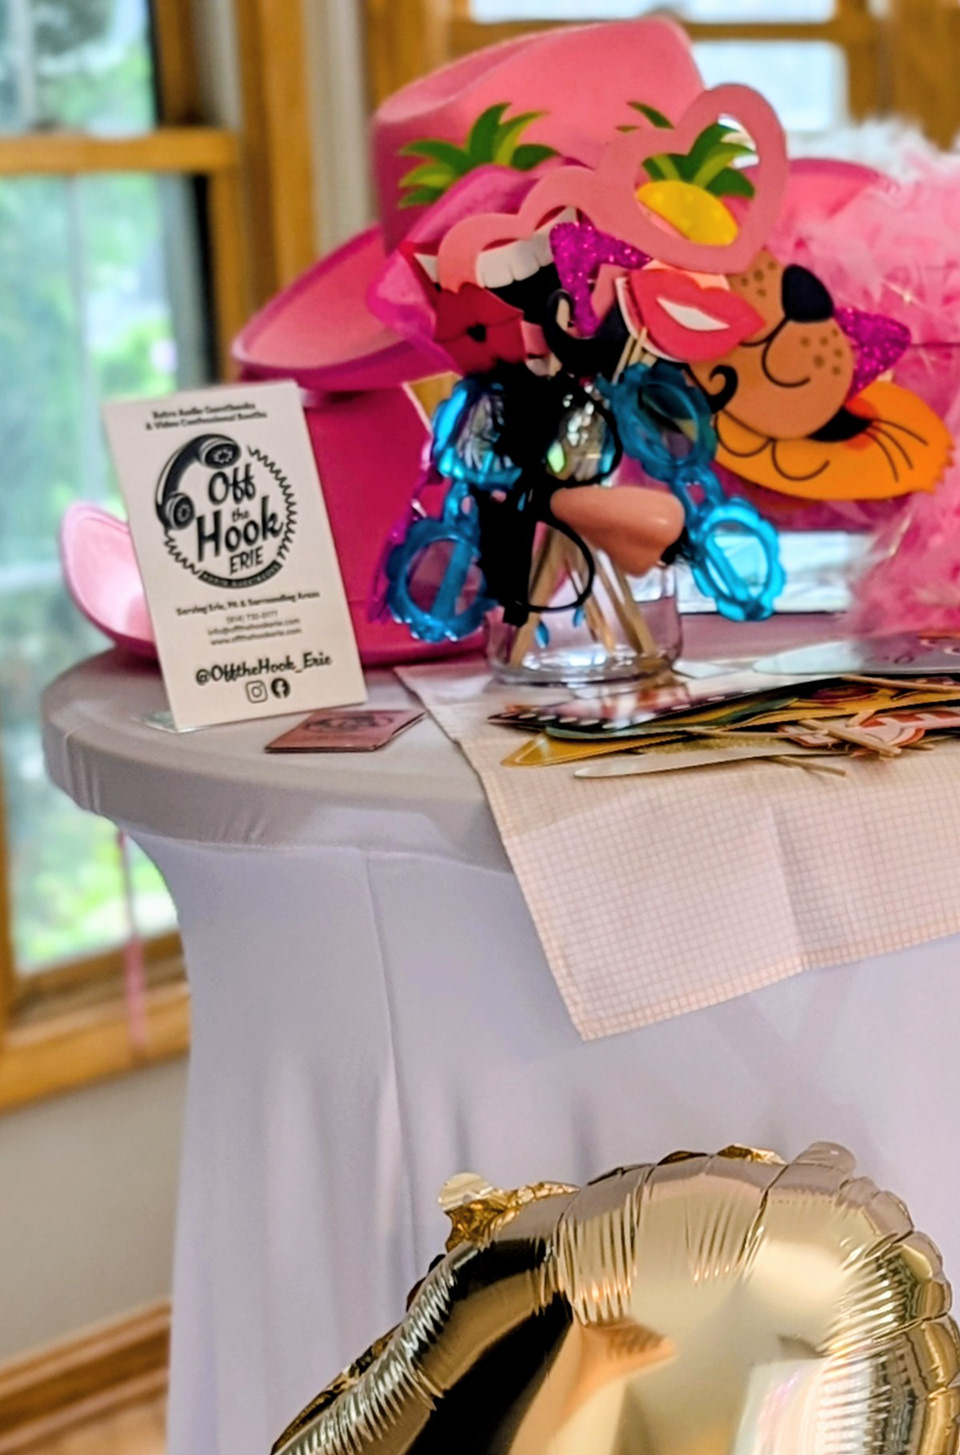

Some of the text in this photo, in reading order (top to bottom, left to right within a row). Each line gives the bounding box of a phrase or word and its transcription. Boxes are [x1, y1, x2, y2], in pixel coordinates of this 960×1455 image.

[207, 462, 256, 506] Off
[196, 495, 284, 563] Hook
[231, 507, 250, 523] the
[229, 545, 264, 576] ERIE
[247, 593, 296, 607] Surrounding
[297, 590, 320, 600] Areas
[195, 651, 333, 686] @OfftheHook_Erie
